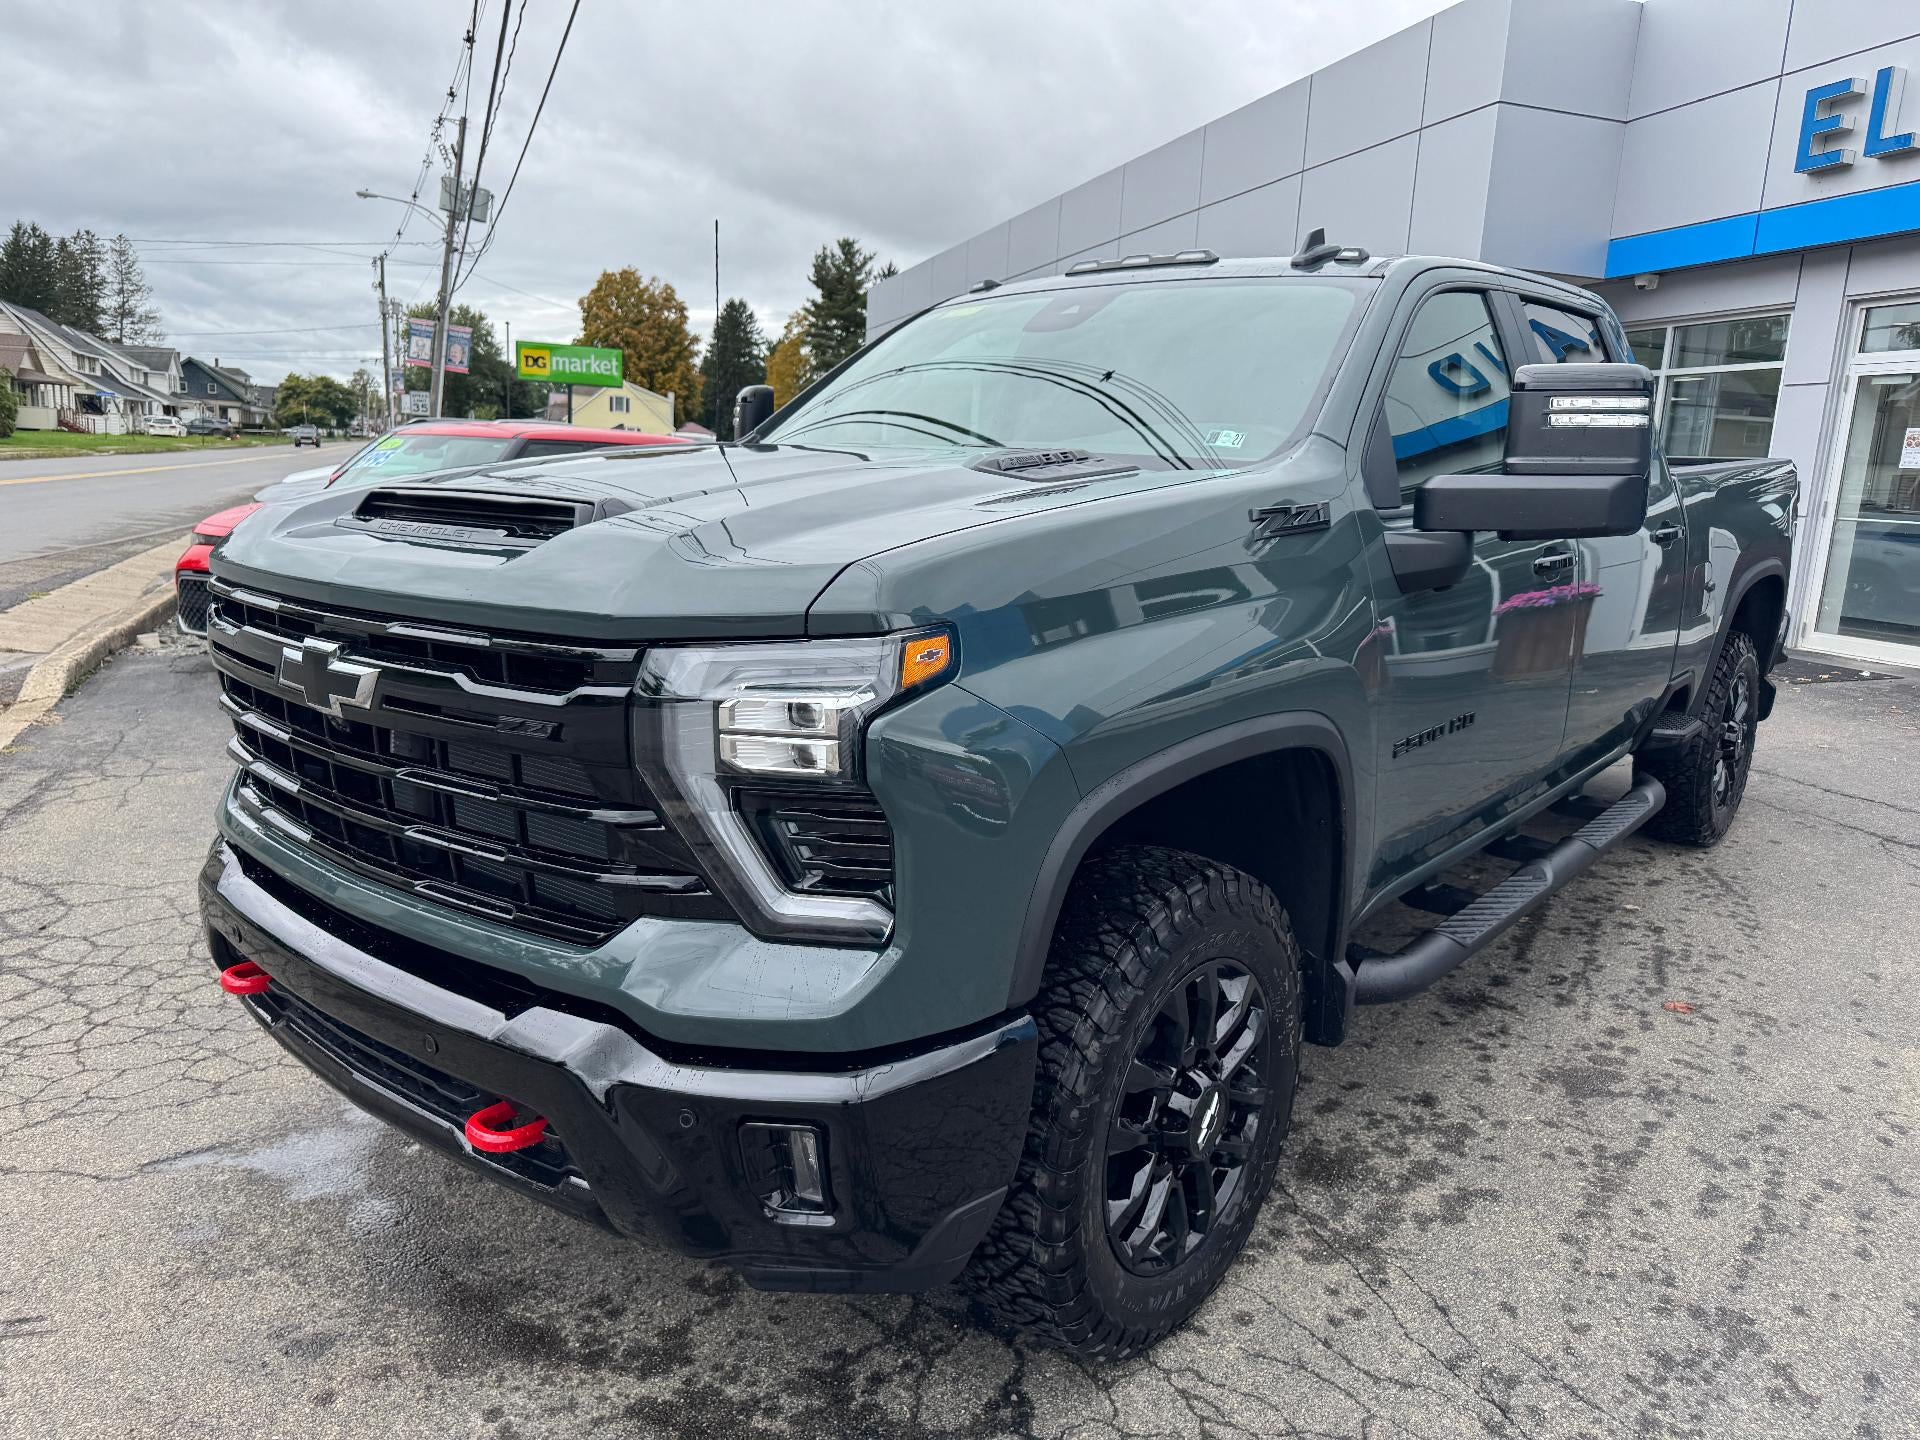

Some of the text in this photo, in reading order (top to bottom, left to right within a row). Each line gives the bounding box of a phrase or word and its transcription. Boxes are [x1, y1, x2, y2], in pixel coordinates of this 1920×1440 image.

[524, 354, 619, 376] DG market
[412, 403, 428, 413] 35
[379, 520, 481, 541] CHEVROLET
[1392, 711, 1477, 760] 2500 HD
